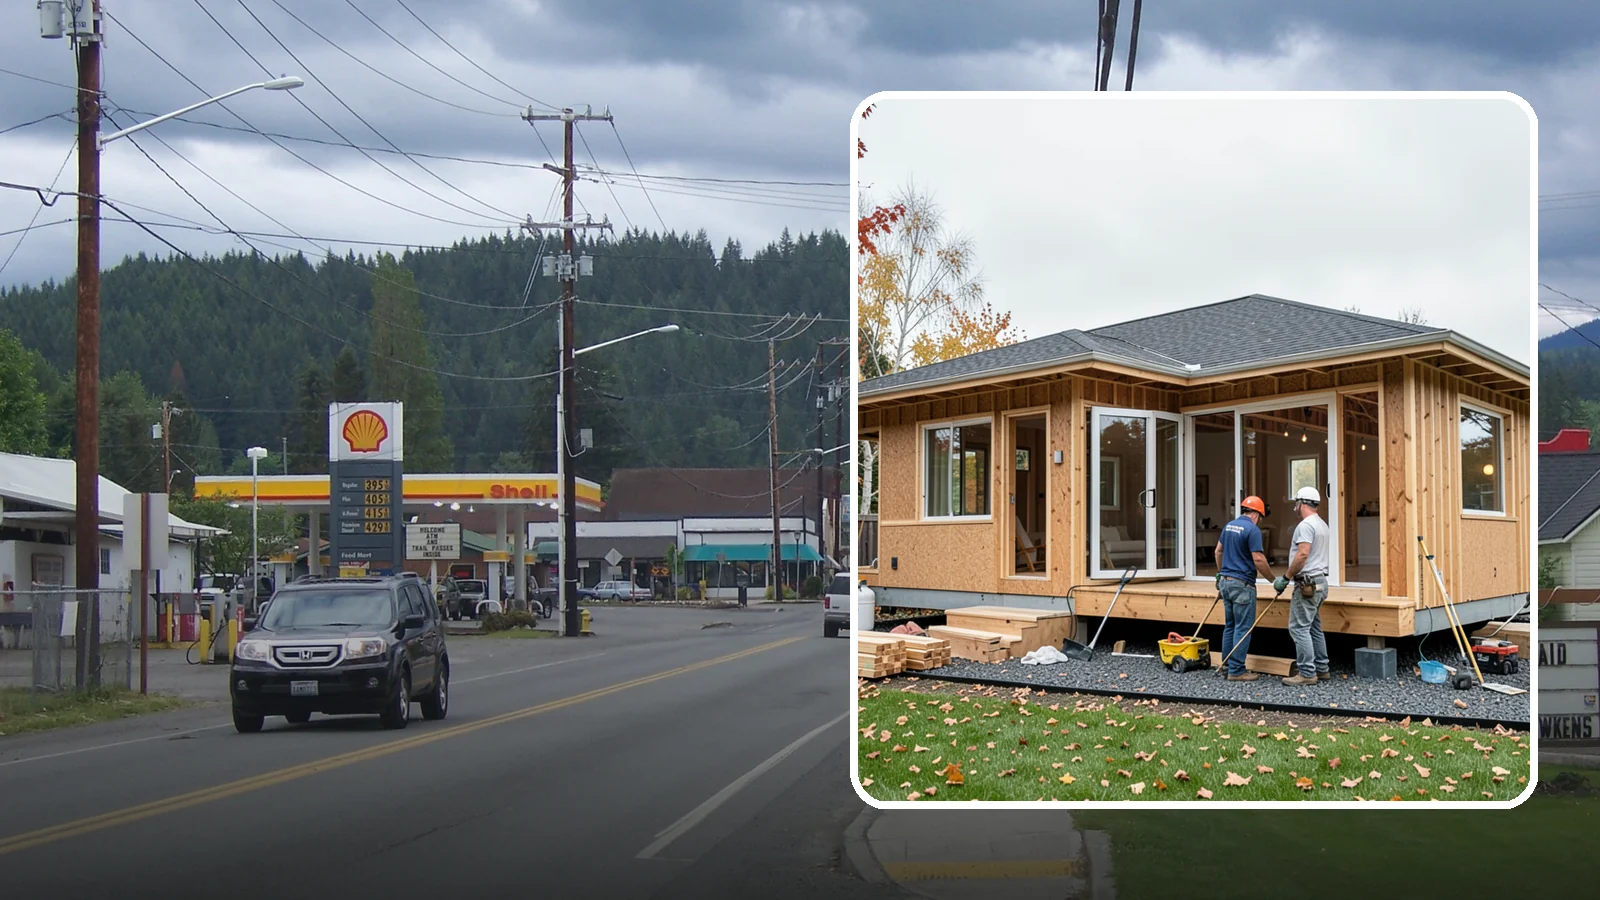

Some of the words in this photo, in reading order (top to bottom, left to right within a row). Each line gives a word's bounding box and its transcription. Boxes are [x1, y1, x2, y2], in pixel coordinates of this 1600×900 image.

[365, 480, 384, 490] 395
[490, 484, 547, 499] Shell
[365, 494, 384, 504] 405
[365, 508, 384, 518] 415
[365, 522, 384, 532] 429
